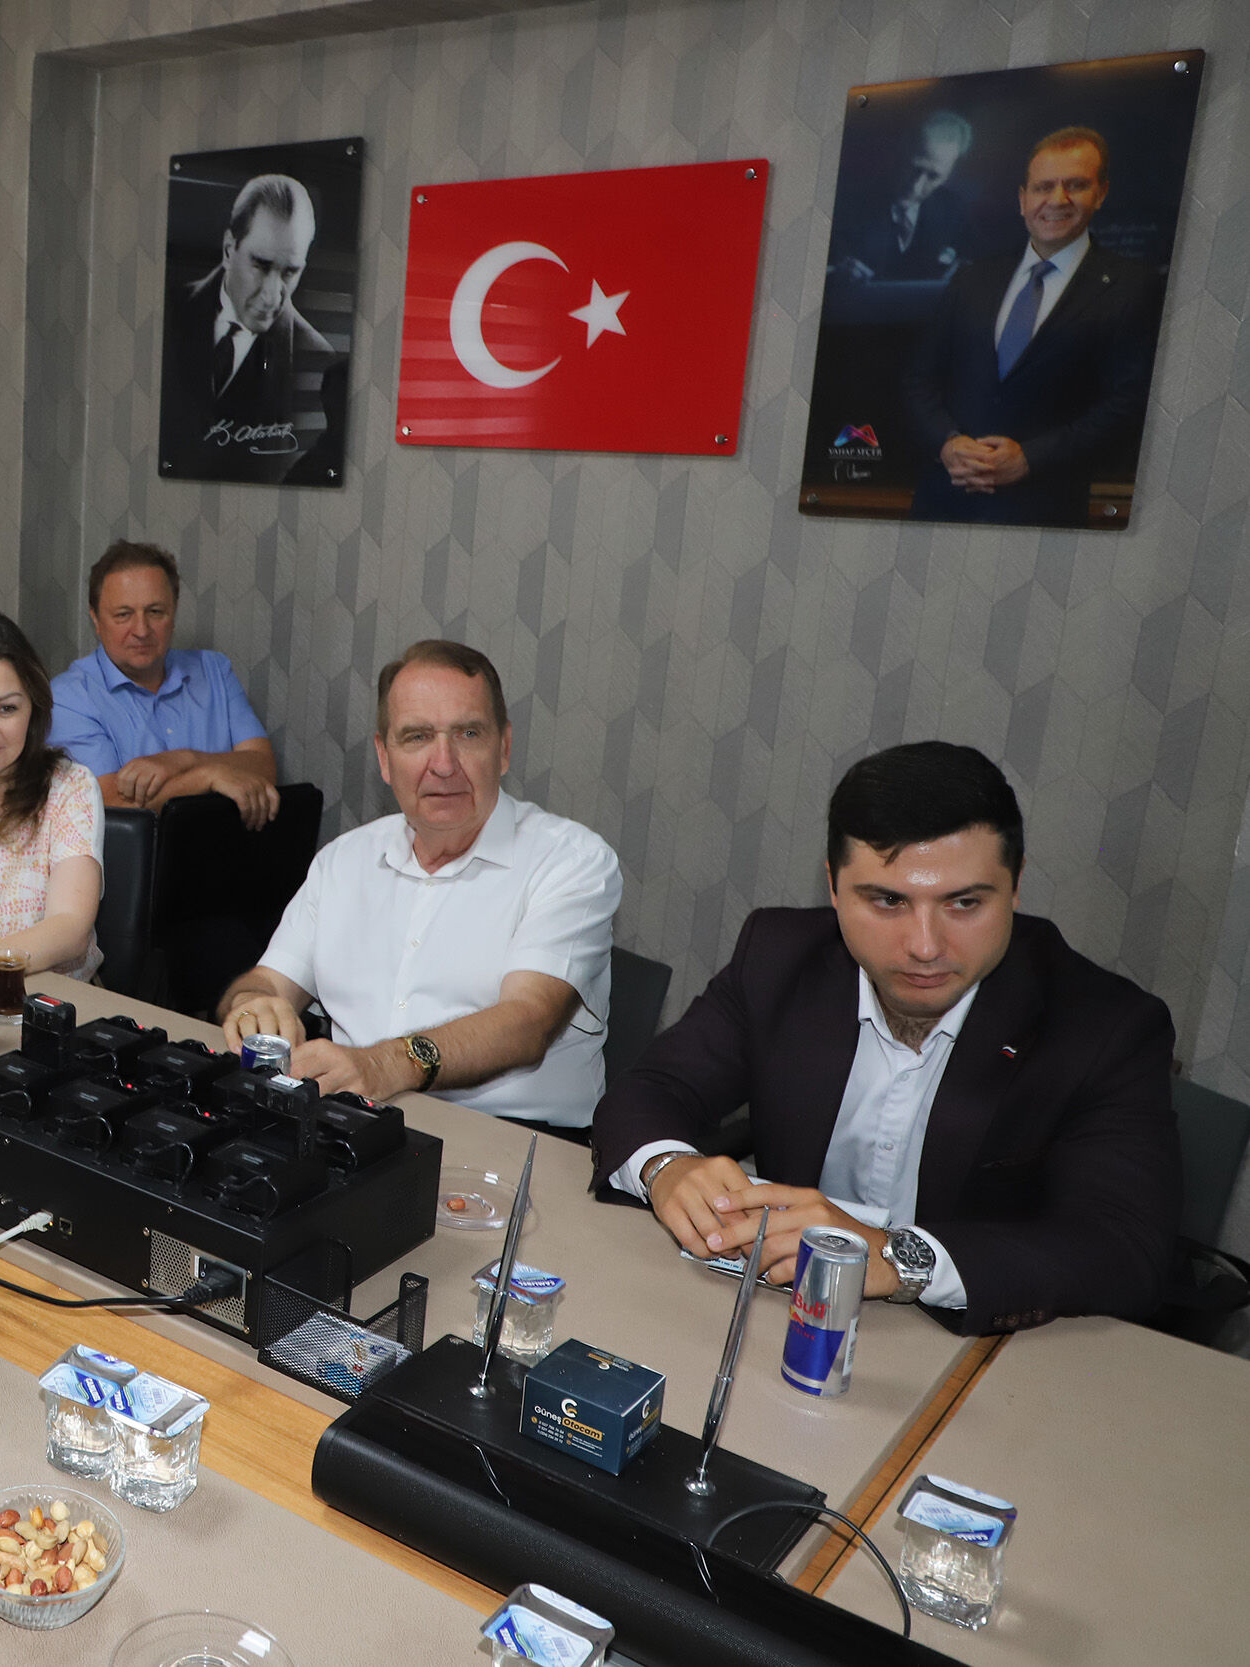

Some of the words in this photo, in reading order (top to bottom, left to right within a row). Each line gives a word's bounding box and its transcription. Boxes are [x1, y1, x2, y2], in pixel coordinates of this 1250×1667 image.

[794, 1292, 826, 1319] Bull
[534, 1405, 562, 1424] Güneş
[564, 1418, 600, 1440] Otocam
